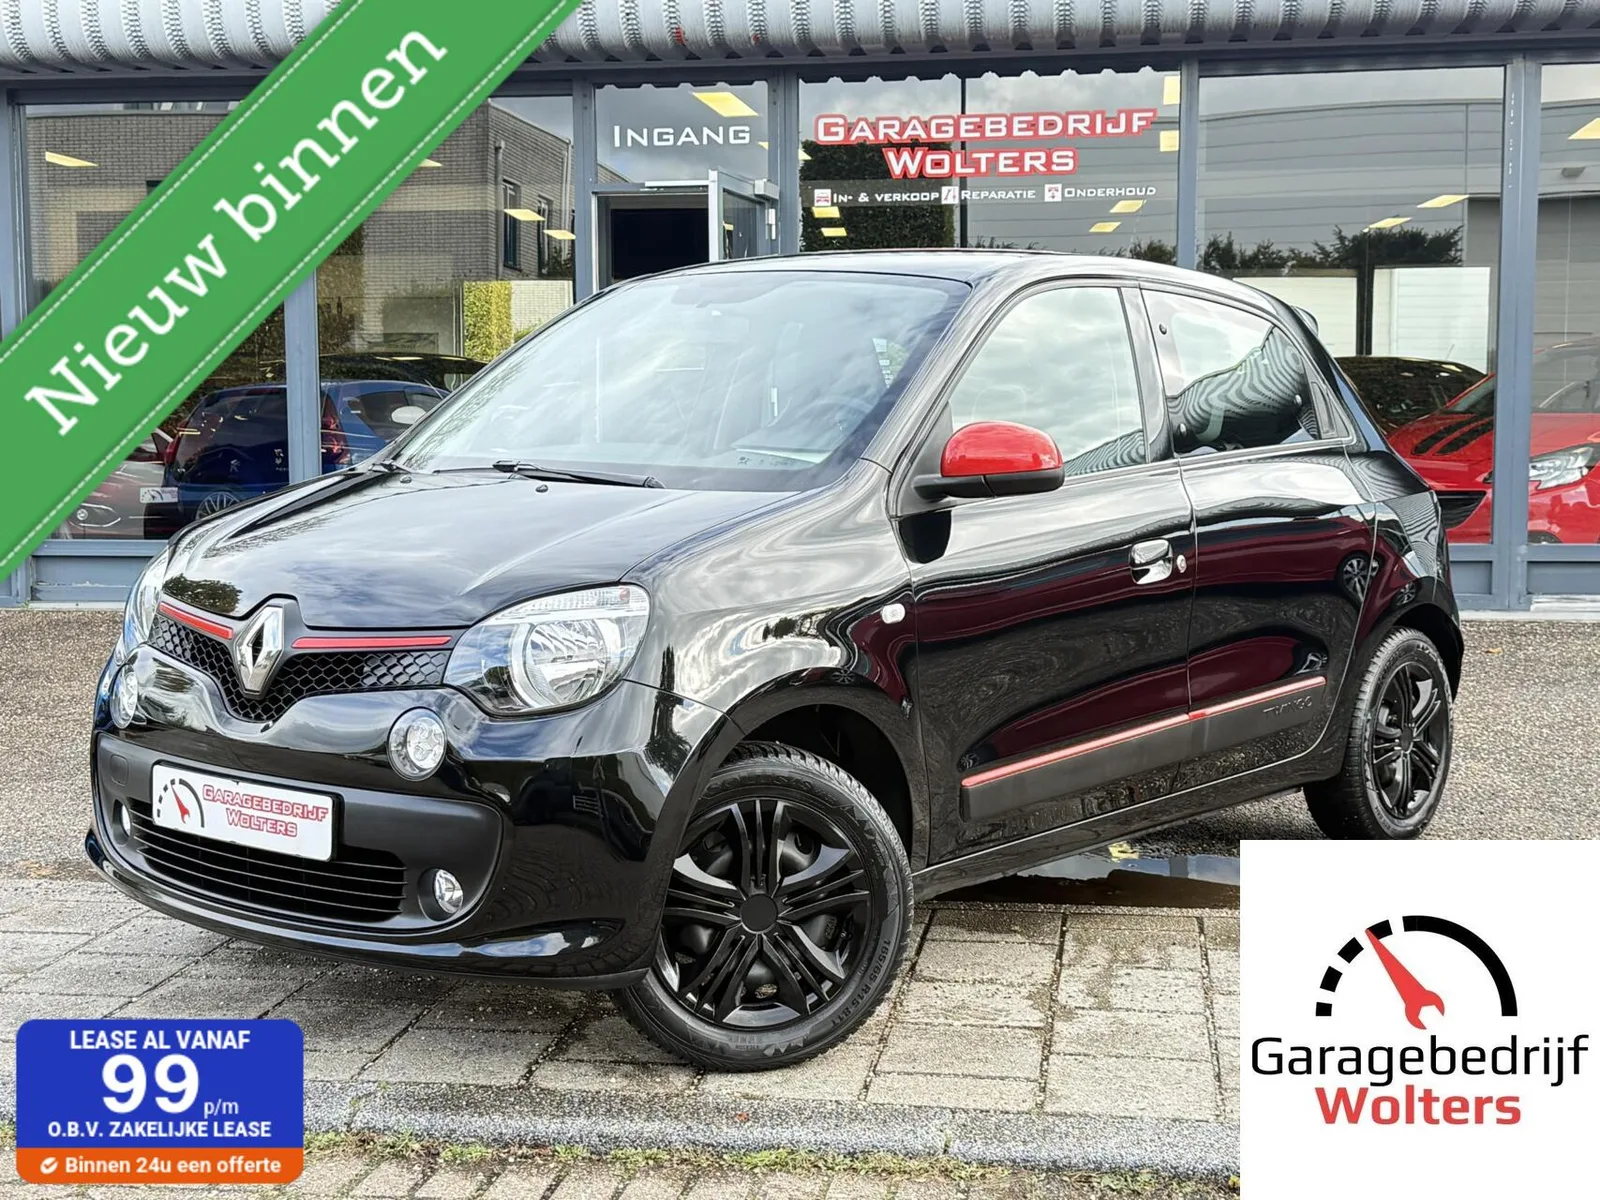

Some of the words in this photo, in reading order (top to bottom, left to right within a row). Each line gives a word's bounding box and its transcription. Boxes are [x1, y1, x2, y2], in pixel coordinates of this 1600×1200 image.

[613, 124, 751, 148] INGANG
[815, 108, 1157, 144] GARAGEBEDRIJF
[882, 146, 1078, 178] WOLTERS
[858, 192, 870, 203] &
[875, 192, 940, 201] VERKOOP
[961, 189, 1036, 200] REPARATIE
[1064, 187, 1157, 197] ONDERHOUD
[202, 784, 329, 821] GARAGEBEDRIJF
[225, 807, 298, 838] WOLTERS
